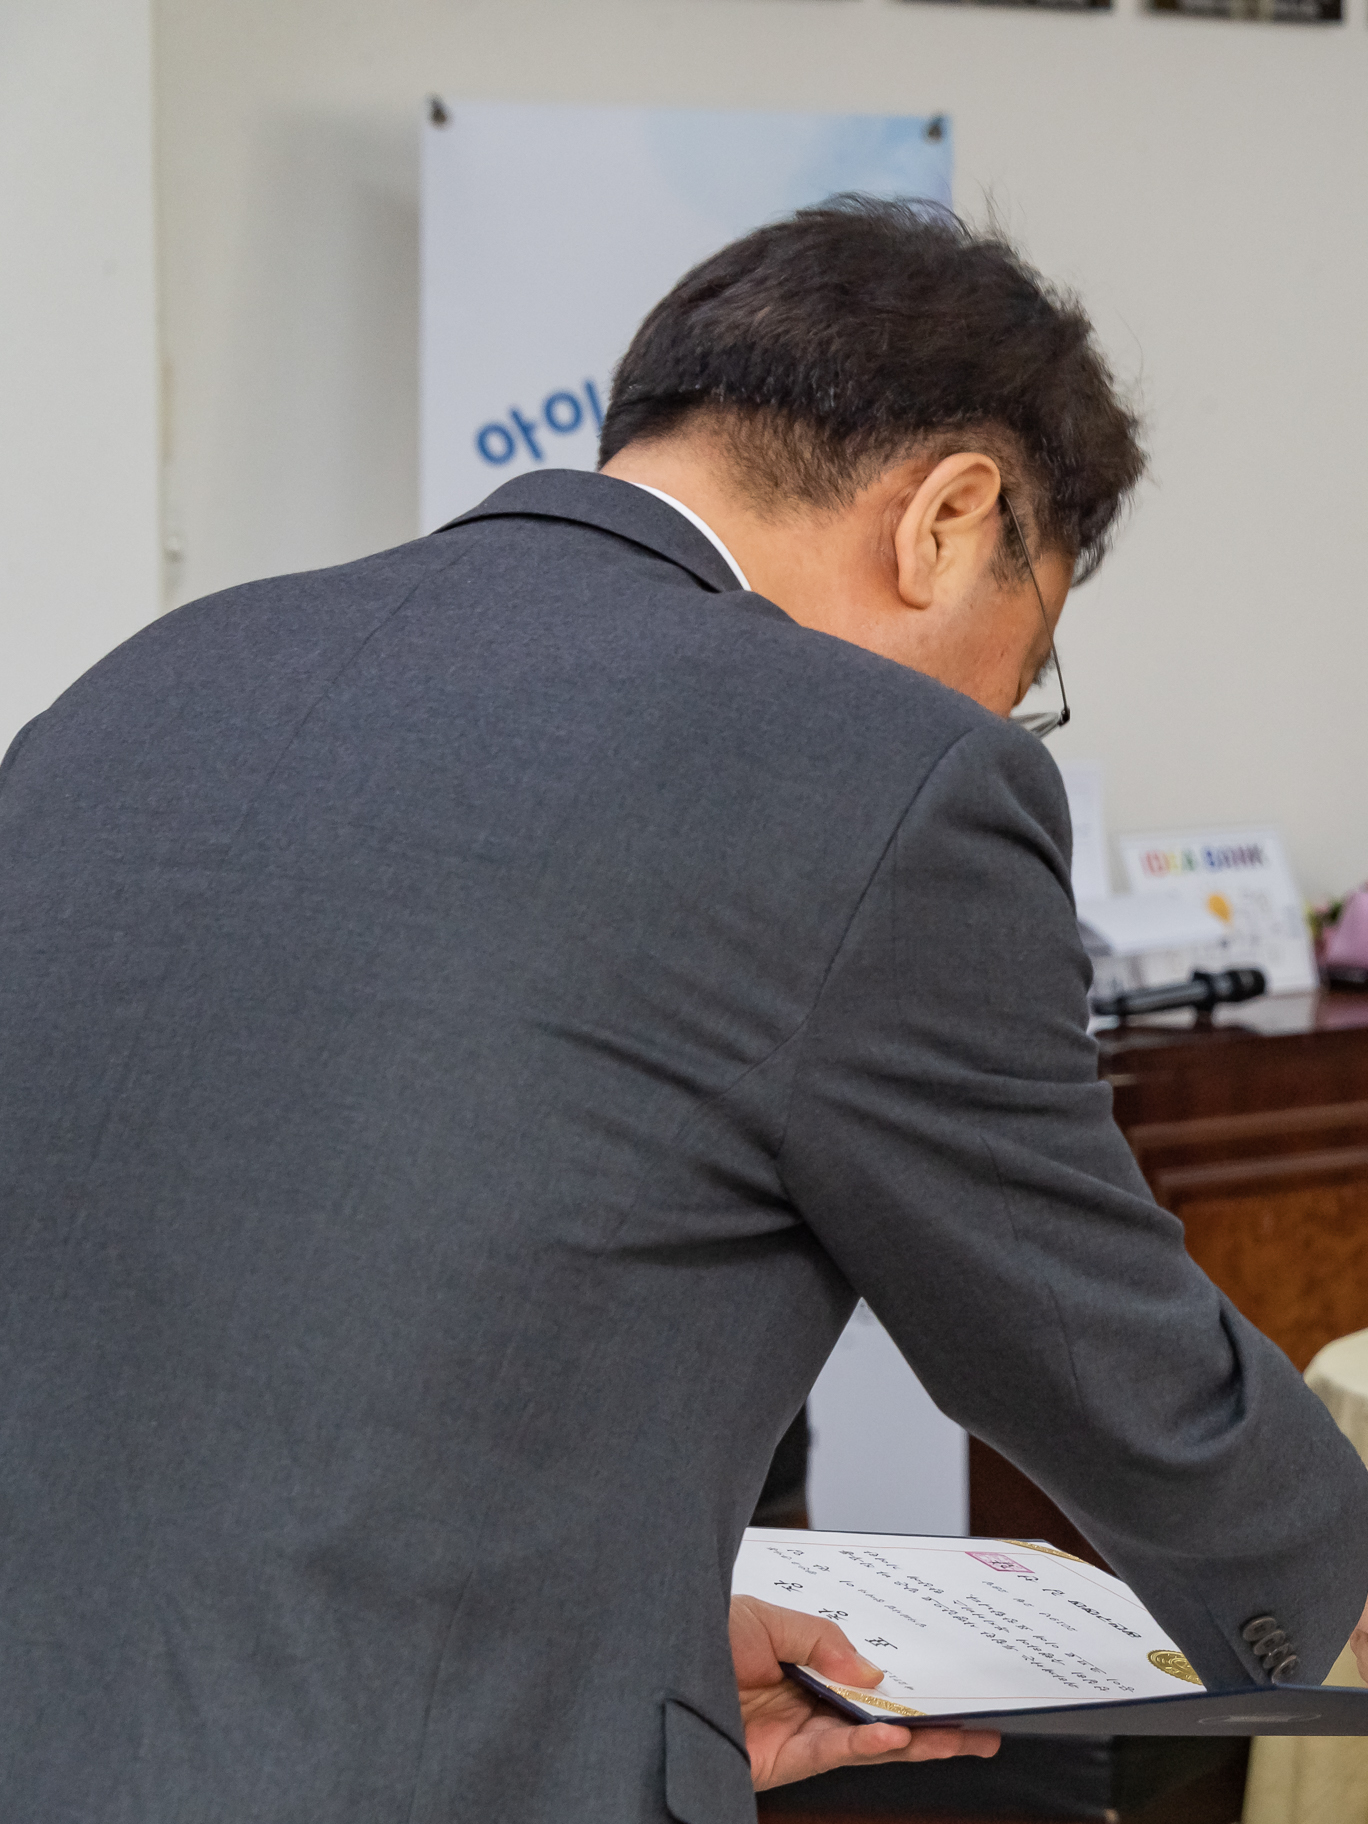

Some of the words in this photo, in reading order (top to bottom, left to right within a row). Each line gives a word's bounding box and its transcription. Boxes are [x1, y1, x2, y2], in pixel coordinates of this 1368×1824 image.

[477, 377, 603, 464] 아이
[773, 1579, 804, 1593] 장
[817, 1607, 849, 1621] 창
[863, 1636, 899, 1650] 표
